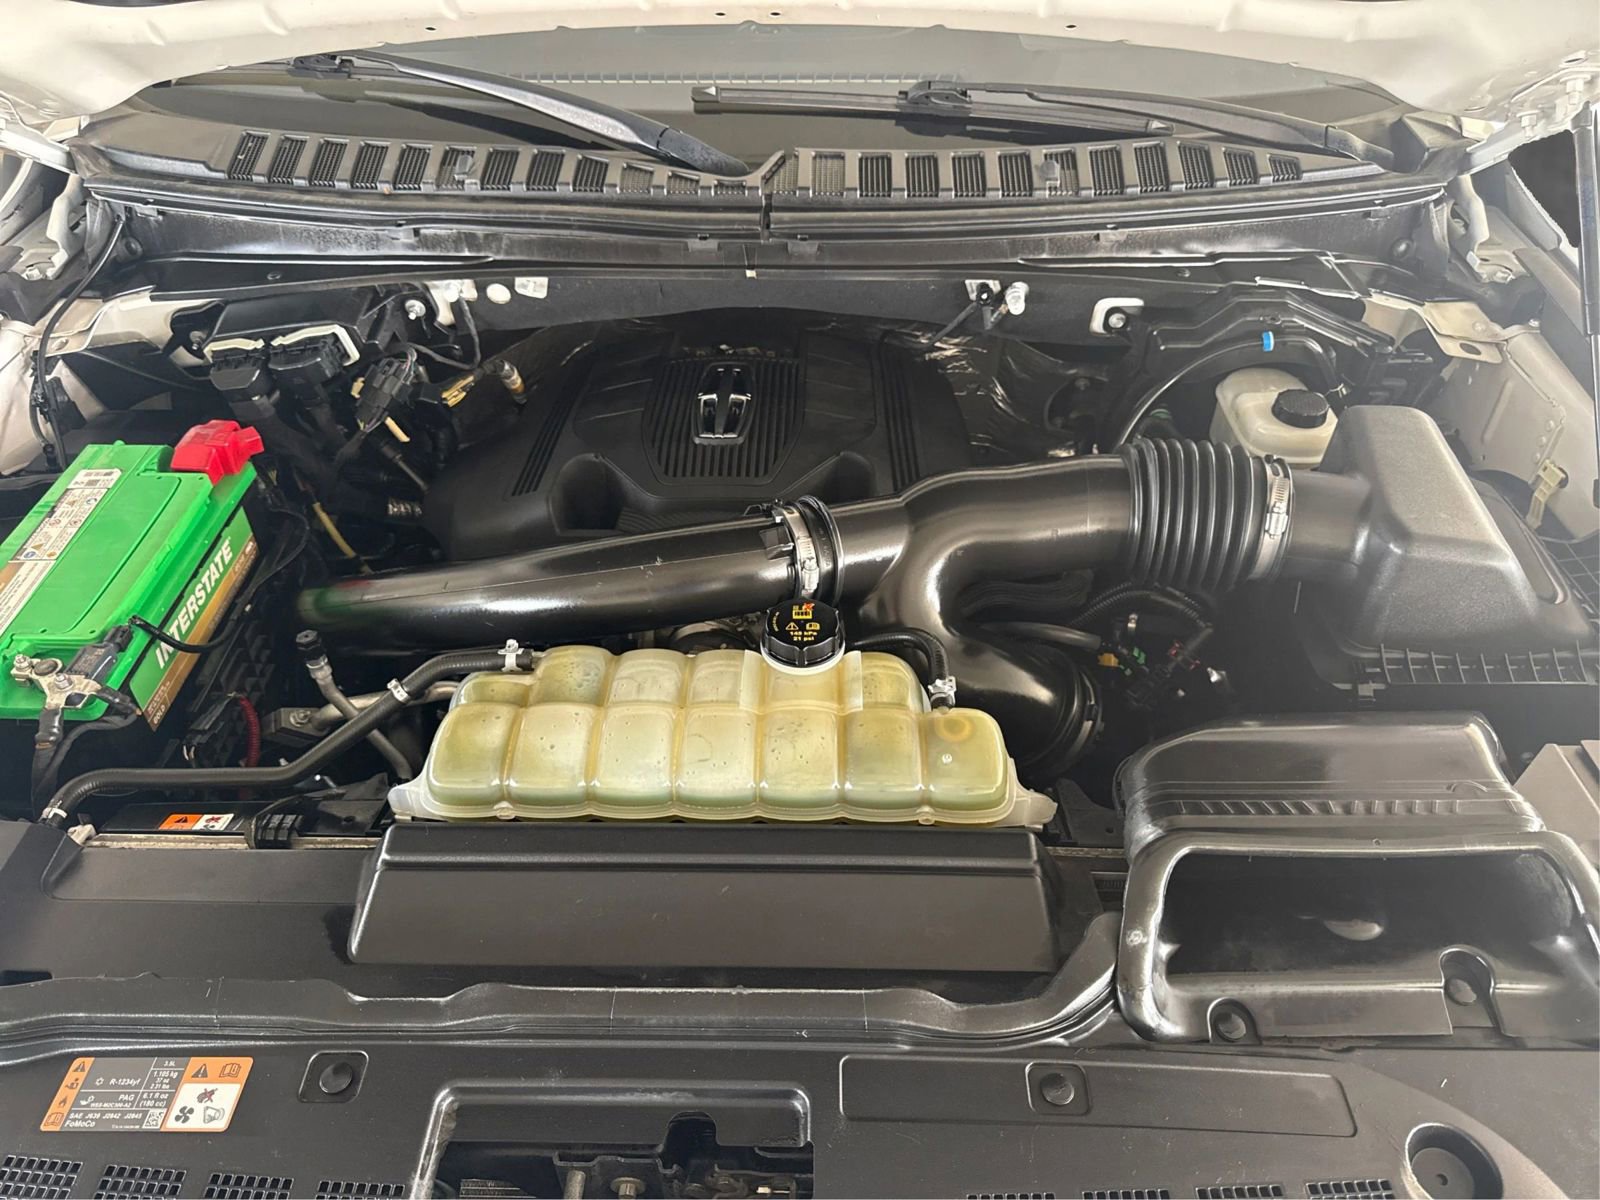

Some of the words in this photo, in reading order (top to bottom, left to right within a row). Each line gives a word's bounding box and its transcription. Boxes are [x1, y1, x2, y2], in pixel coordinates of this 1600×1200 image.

[155, 539, 233, 669] INTERSTATE
[170, 1070, 179, 1079] kg
[109, 1078, 142, 1087] R-1234yf
[64, 1120, 96, 1128] FoMoCo
